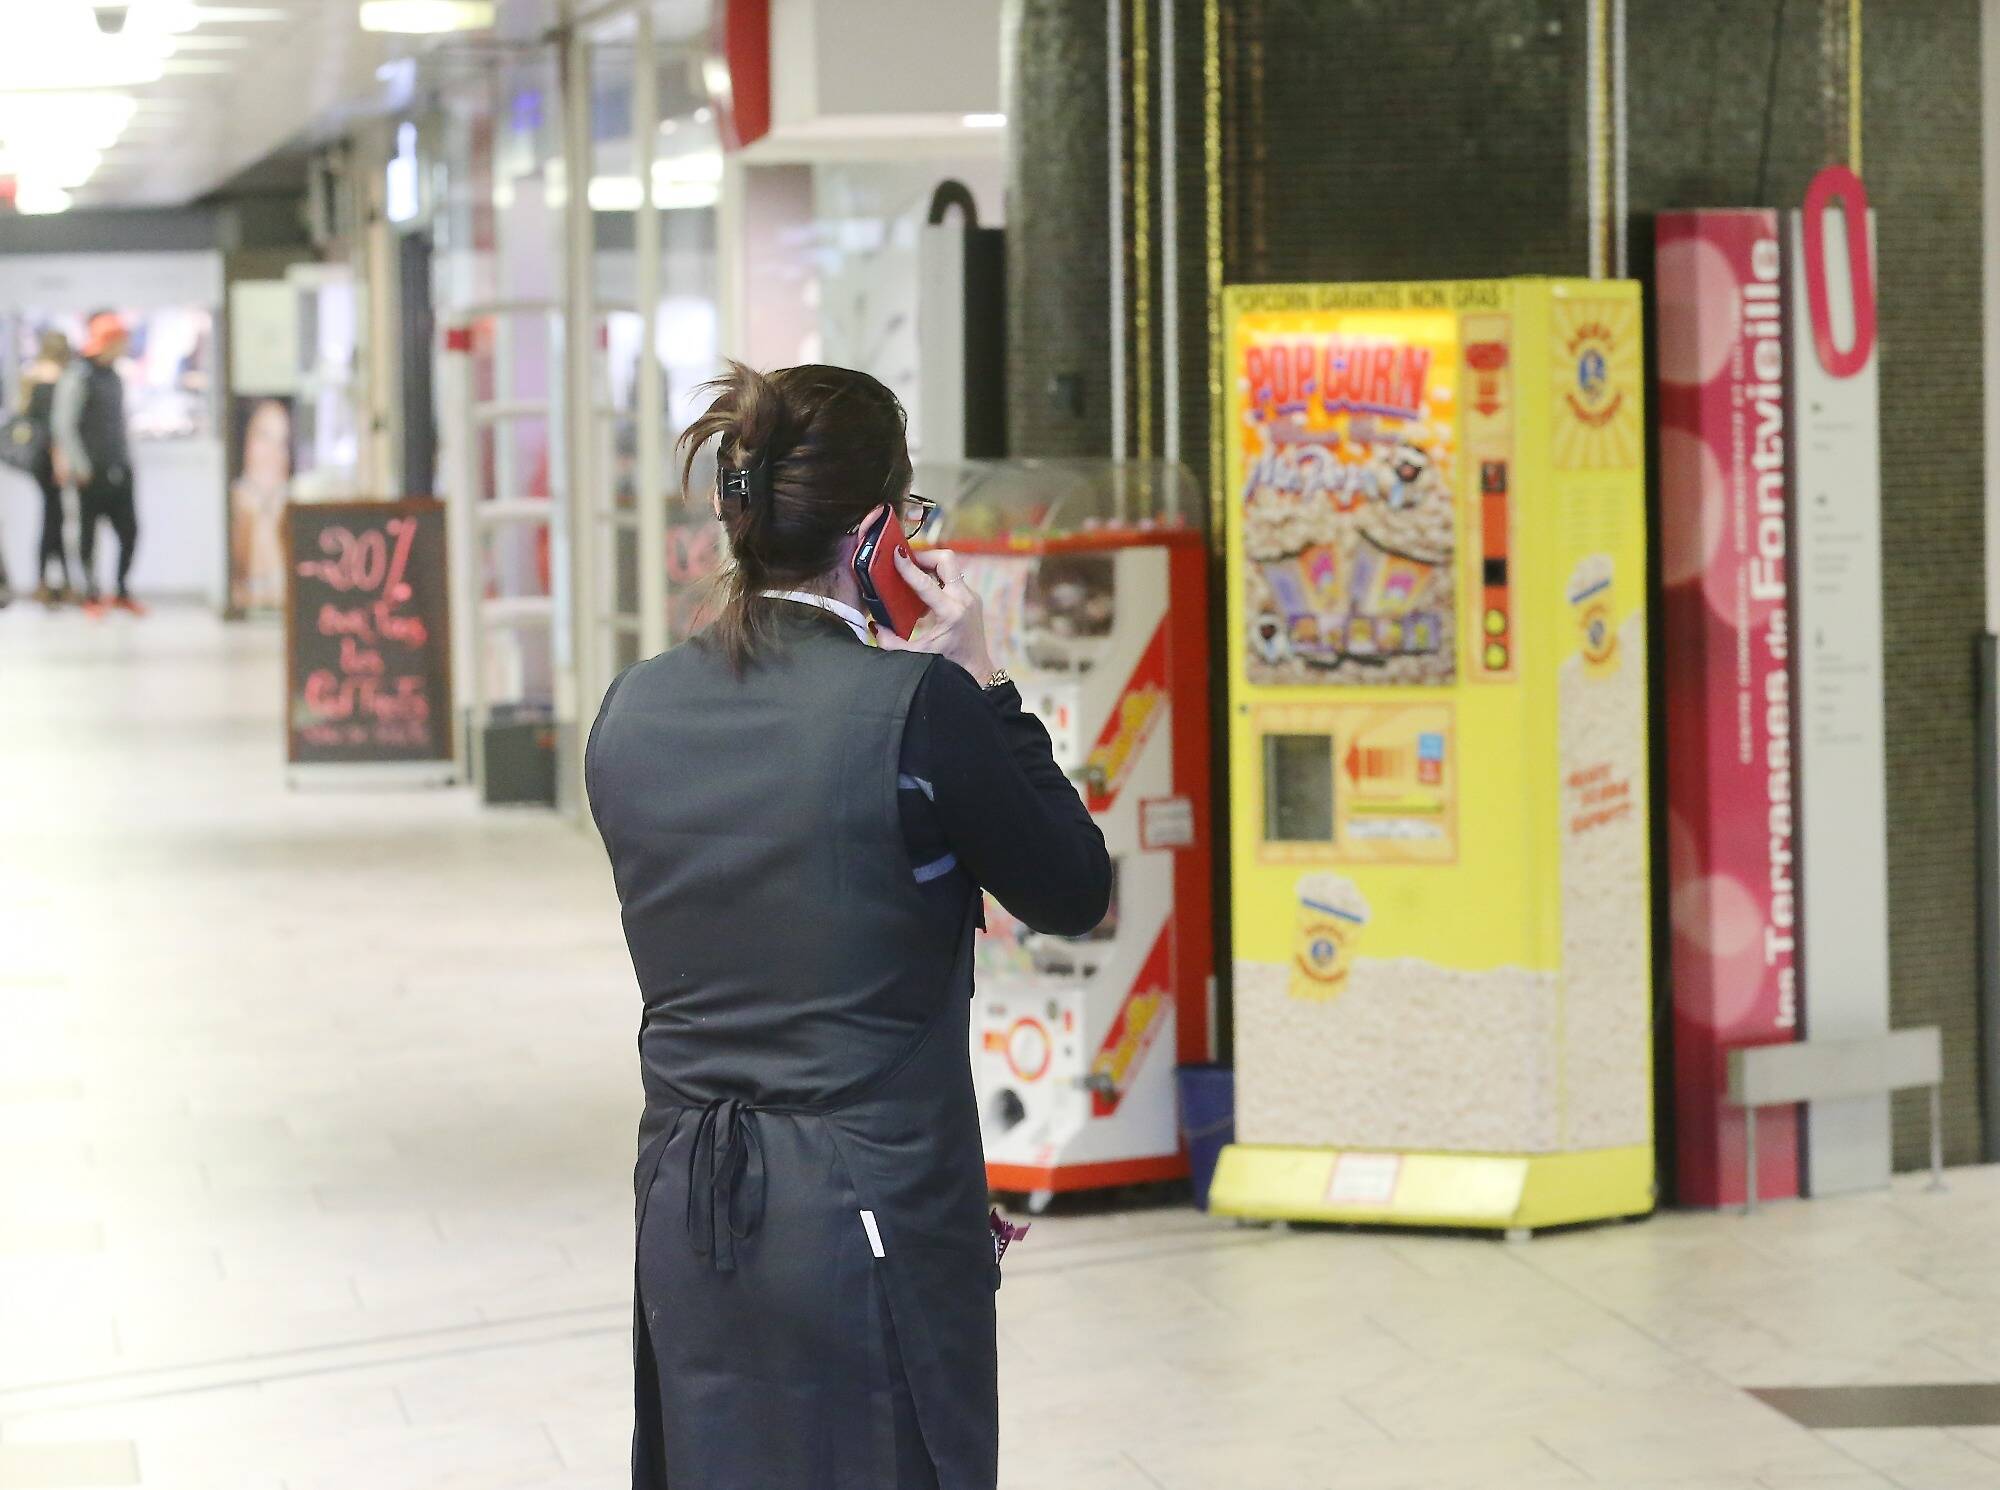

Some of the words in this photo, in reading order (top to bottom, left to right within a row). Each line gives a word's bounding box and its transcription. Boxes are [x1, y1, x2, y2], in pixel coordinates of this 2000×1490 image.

[1246, 343, 1316, 411] POP
[1324, 336, 1430, 411] CORN
[1745, 238, 1787, 601] Fontvieille
[296, 515, 418, 602] -20%
[1766, 668, 1794, 964] Terrasses
